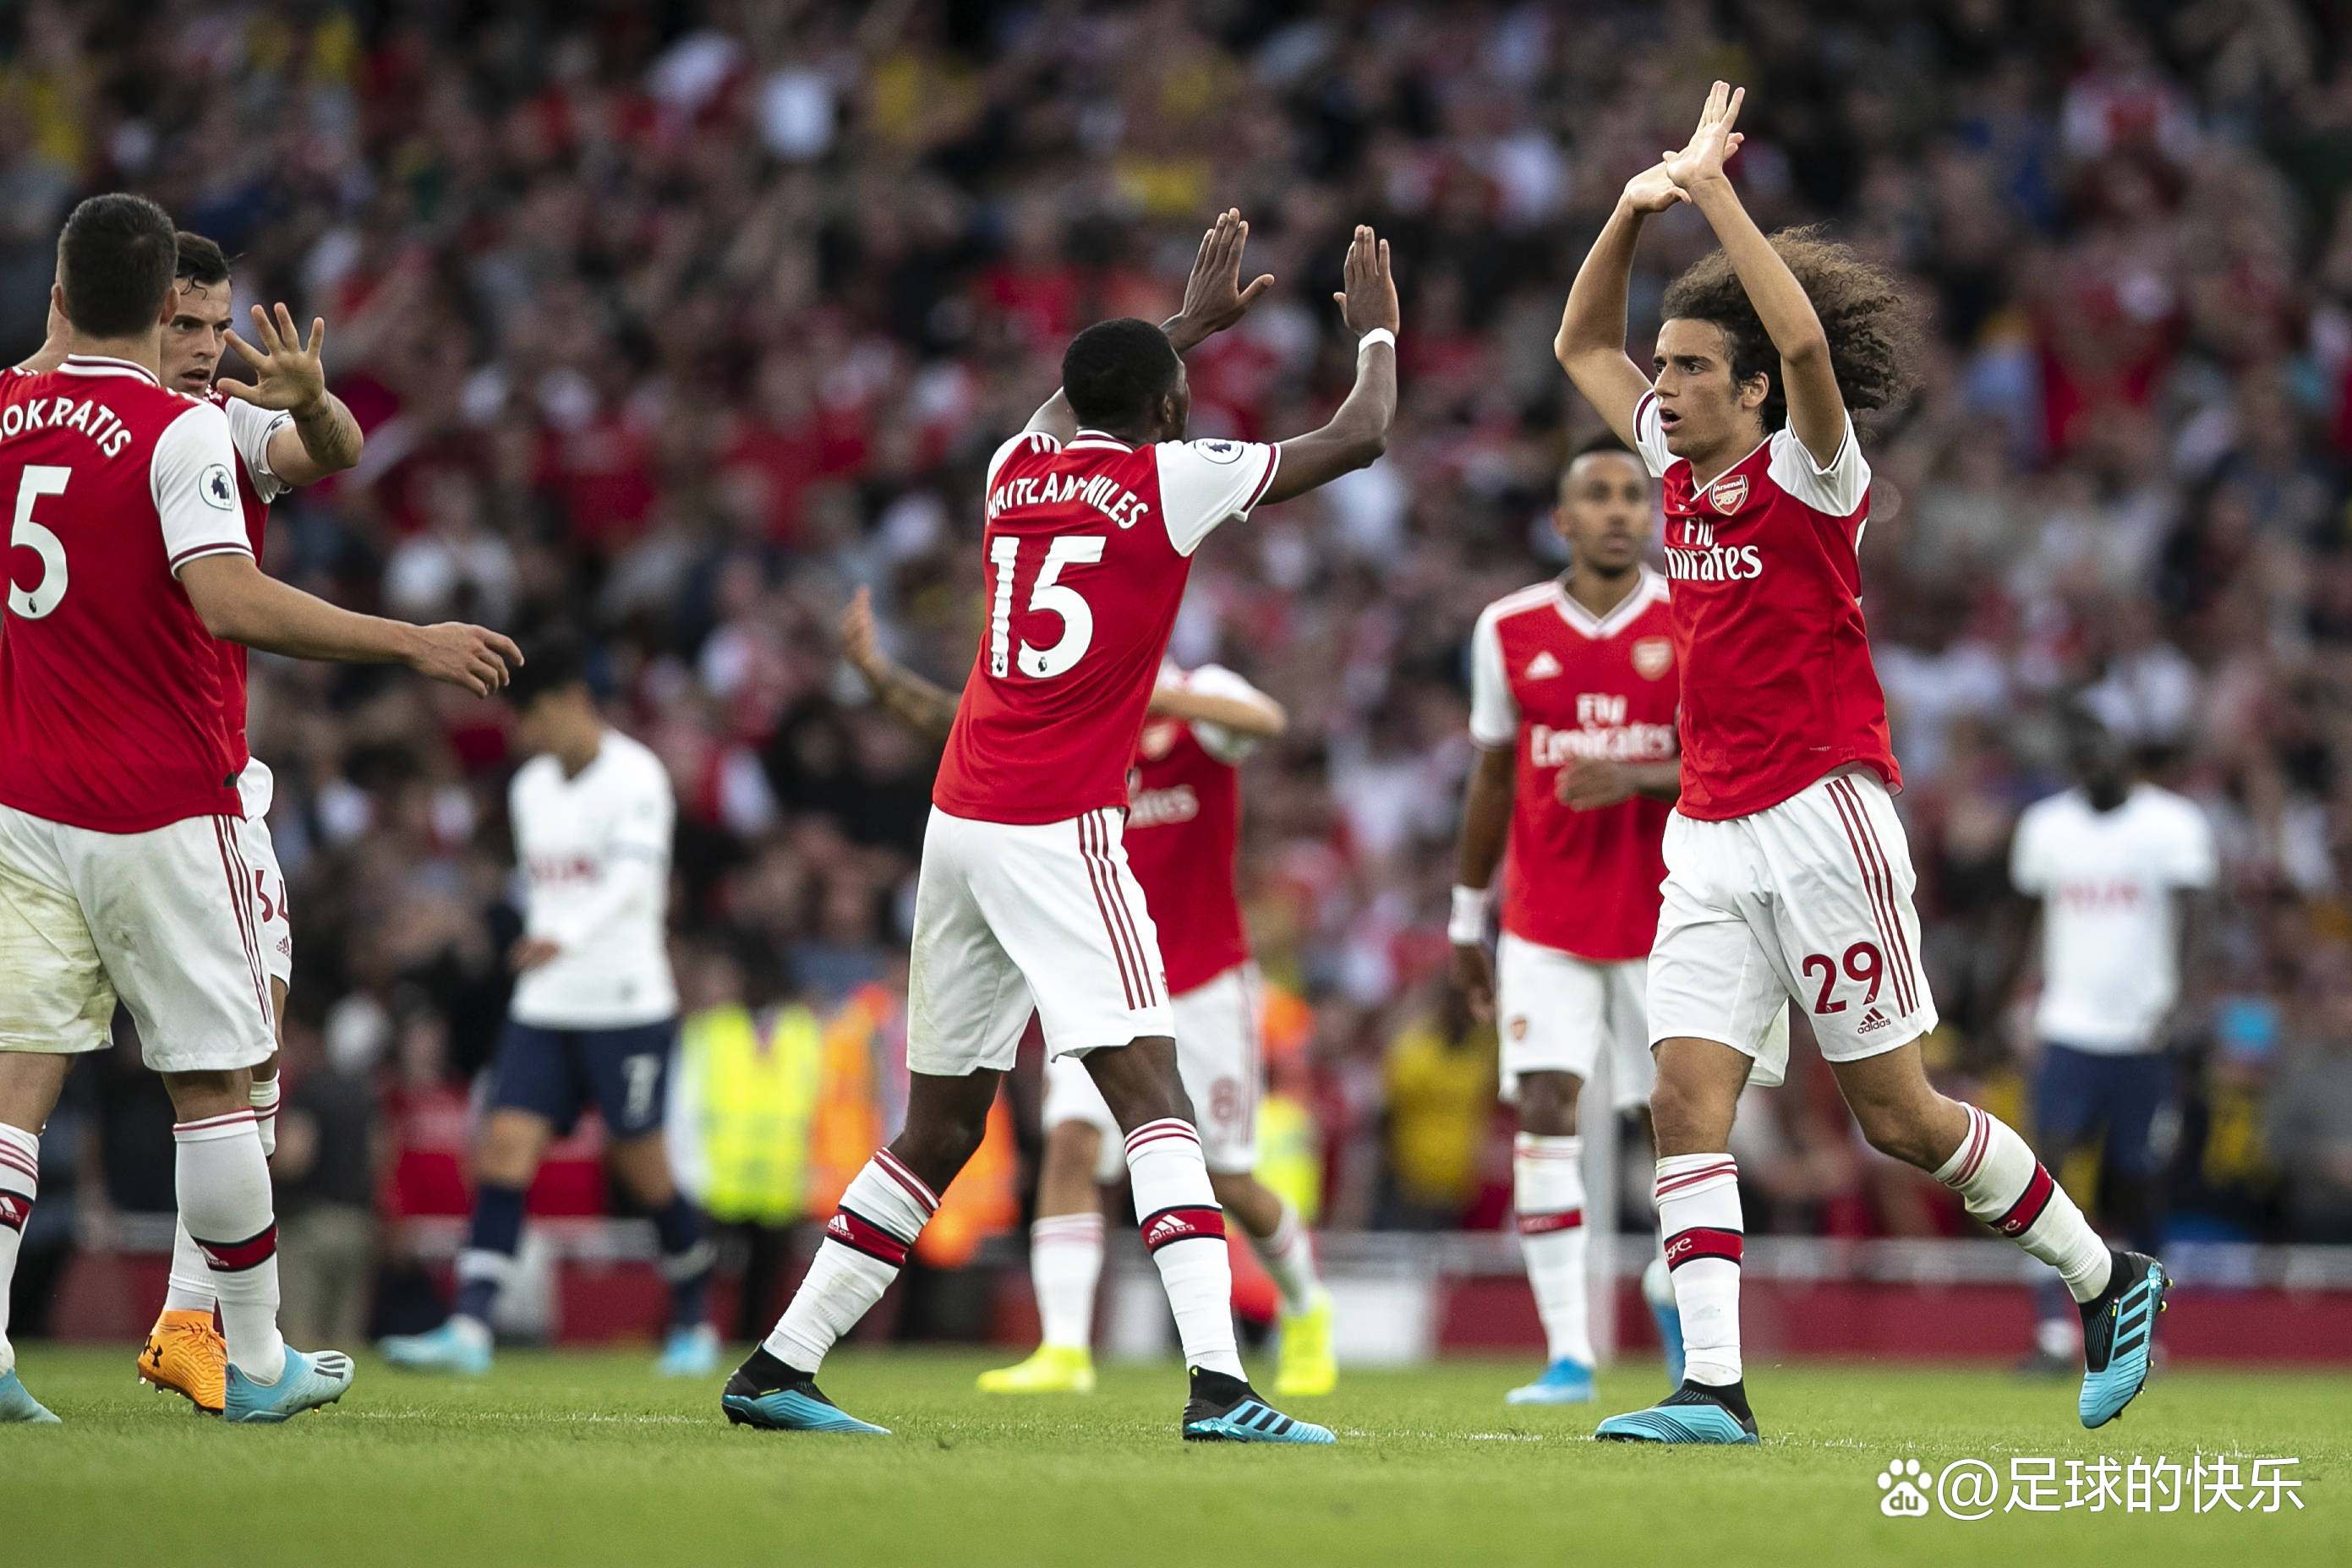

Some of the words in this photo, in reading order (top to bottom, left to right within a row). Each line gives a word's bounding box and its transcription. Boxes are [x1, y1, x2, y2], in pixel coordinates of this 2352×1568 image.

[0, 396, 132, 458] OKRATIS
[1715, 478, 1742, 492] Arsenal
[8, 464, 72, 620] 5
[1664, 542, 1763, 581] mirates
[990, 535, 1107, 678] 15
[1802, 941, 1884, 1014] 29
[1857, 1017, 1892, 1035] adidas
[1148, 1224, 1195, 1244] adidas
